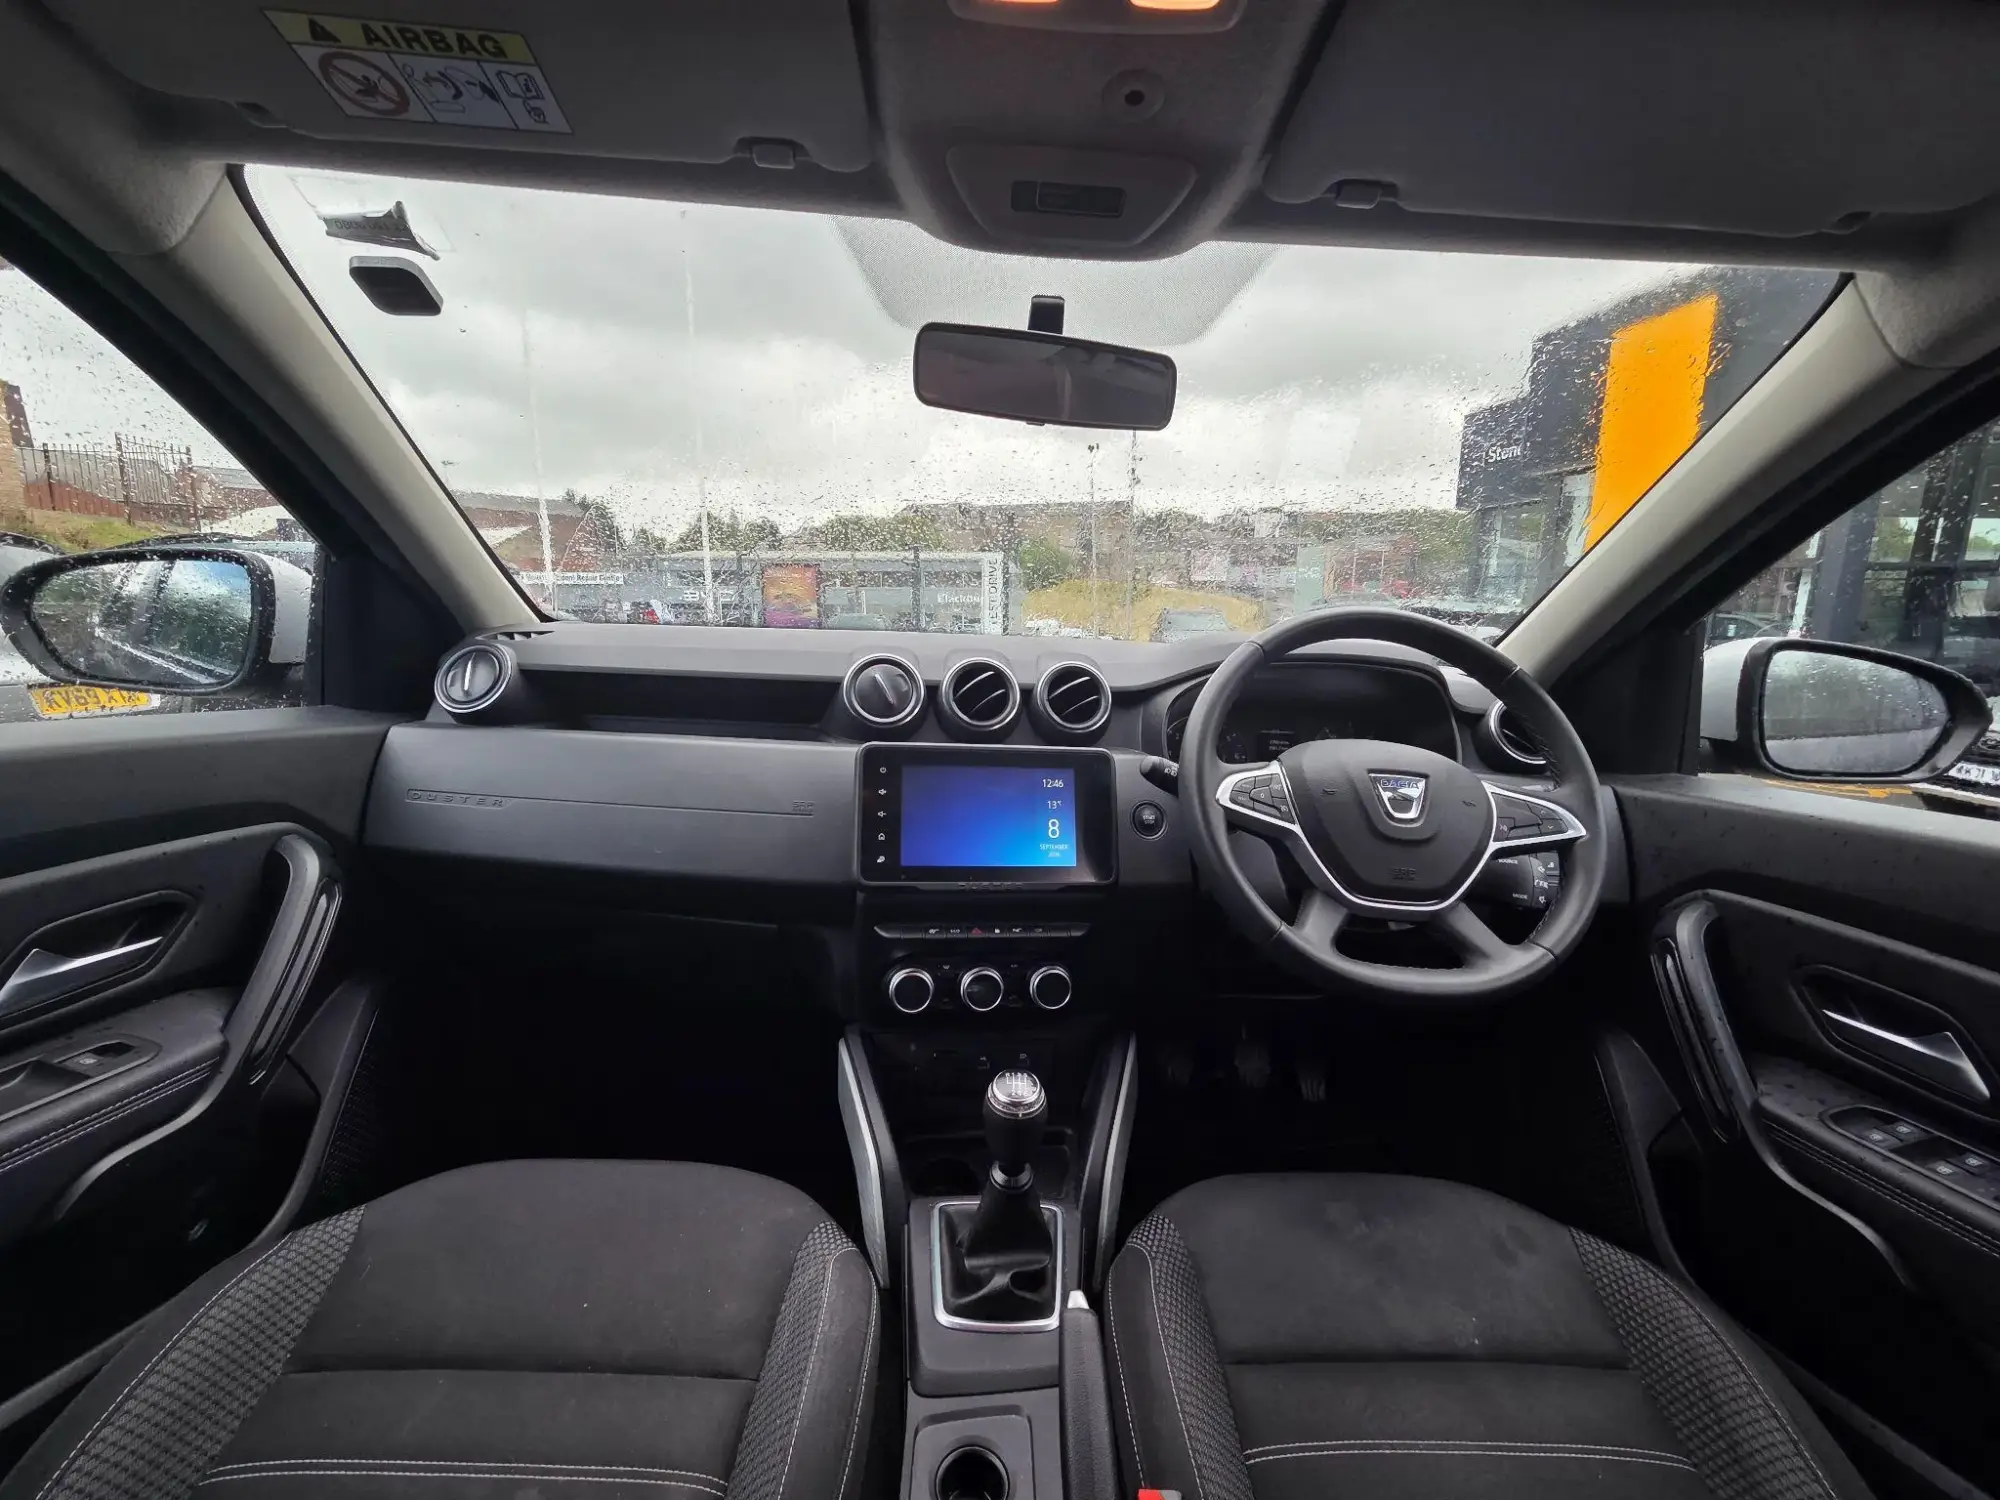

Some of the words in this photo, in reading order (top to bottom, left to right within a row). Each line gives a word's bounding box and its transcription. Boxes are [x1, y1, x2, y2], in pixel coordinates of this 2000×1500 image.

[359, 22, 509, 59] AIRBAG
[988, 558, 999, 594] DRIVE
[1042, 778, 1064, 788] 12:46
[1380, 778, 1420, 790] DACIA
[411, 791, 503, 807] DUSTER
[1048, 818, 1060, 839] 8
